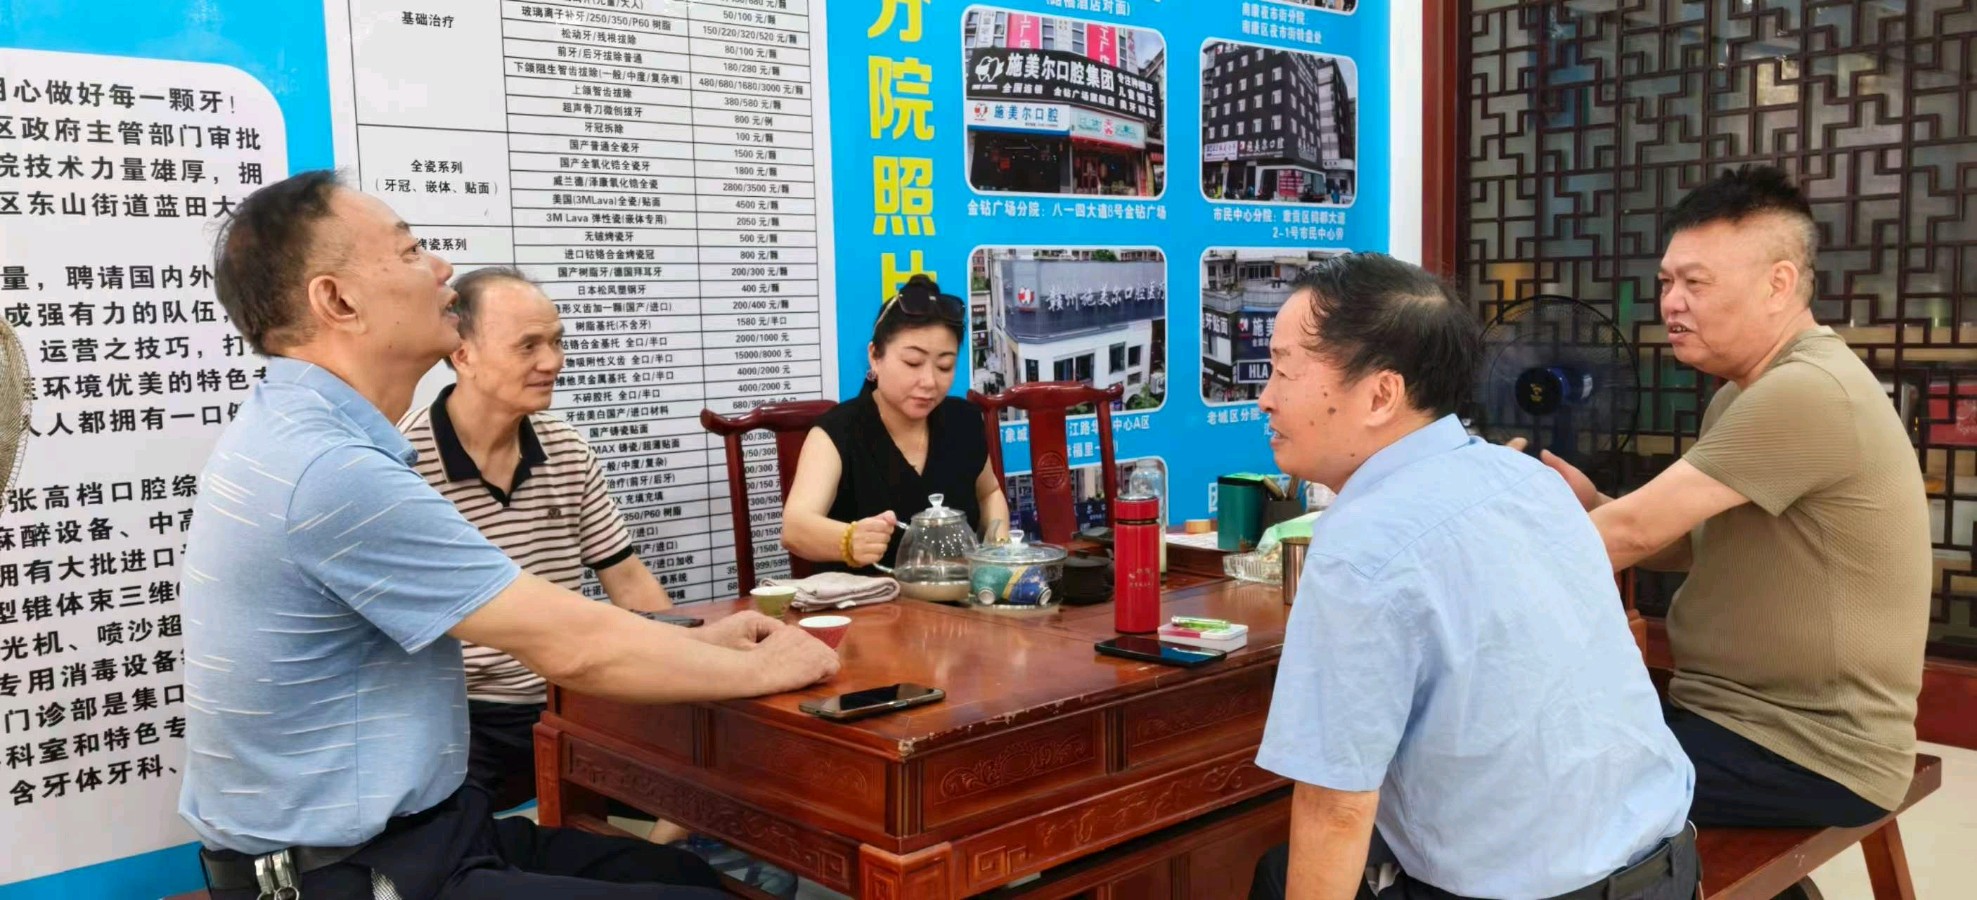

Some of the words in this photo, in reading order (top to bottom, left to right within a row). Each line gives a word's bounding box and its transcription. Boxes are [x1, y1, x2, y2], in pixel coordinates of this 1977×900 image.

[402, 11, 455, 28] 基础治疗
[723, 10, 752, 21] 50/100
[703, 25, 774, 41] 150/220/320/520
[724, 45, 754, 56] 80/100
[723, 62, 757, 73] 180/280
[1005, 52, 1115, 92] 施美尔口腔集团
[699, 75, 781, 93] 480/680/1680/3000
[0, 77, 236, 114] 心做好每一颗牙！
[734, 115, 750, 125] 800
[994, 105, 1059, 123] 施美尔口腔
[0, 116, 261, 150] 区政府主管部门审批
[736, 132, 751, 142] 100
[569, 139, 640, 153] 国产普通全瓷牙
[734, 149, 754, 159] 1500
[0, 152, 263, 185] 院技术力量雄厚，拥
[411, 159, 463, 174] 全瓷系列
[735, 166, 754, 176] 1800
[723, 182, 767, 193] 2800/3500
[0, 191, 247, 219] 区东山街道蓝田大
[735, 200, 756, 210] 4500
[546, 212, 563, 222] 3M
[566, 213, 589, 223] Lava
[736, 217, 757, 227] 2050
[739, 234, 755, 243] 500
[740, 251, 755, 260] 800
[1, 264, 214, 290] 量，聘请国内外
[731, 267, 765, 276] 200/300
[741, 285, 757, 293] 400
[733, 301, 766, 310] 200/400
[5, 300, 229, 328] 成强有力的队伍，
[736, 317, 756, 326] 1580
[626, 336, 668, 348] 全口/半口
[735, 334, 778, 343] 2000/1000
[40, 334, 258, 363] 运营之技巧，打
[734, 350, 782, 359] 15000/8000
[631, 354, 673, 366] 全口/半口
[632, 371, 674, 383] 全口/半口
[737, 367, 780, 376] 4000/2000
[1249, 364, 1269, 379] HLA
[27, 366, 267, 400] 环境优美的特色
[737, 383, 781, 392] 4000/2000
[619, 389, 661, 401] 全口/半口
[1000, 427, 1028, 443] 象城
[1113, 415, 1150, 433] 中心A区
[590, 444, 616, 455] MAX
[742, 447, 777, 457] /50/300
[1067, 441, 1100, 458] 福里
[8, 474, 198, 513] 张高档口腔综
[752, 544, 778, 555] /1500
[0, 543, 189, 588] 拥有大批进口
[1, 615, 183, 661] 光机、喷沙超
[0, 648, 185, 697] 专用消毒设备
[4, 684, 184, 733] 门诊部是集口
[0, 717, 187, 769] 科室和特色专
[9, 754, 177, 806] 含牙体牙科、
